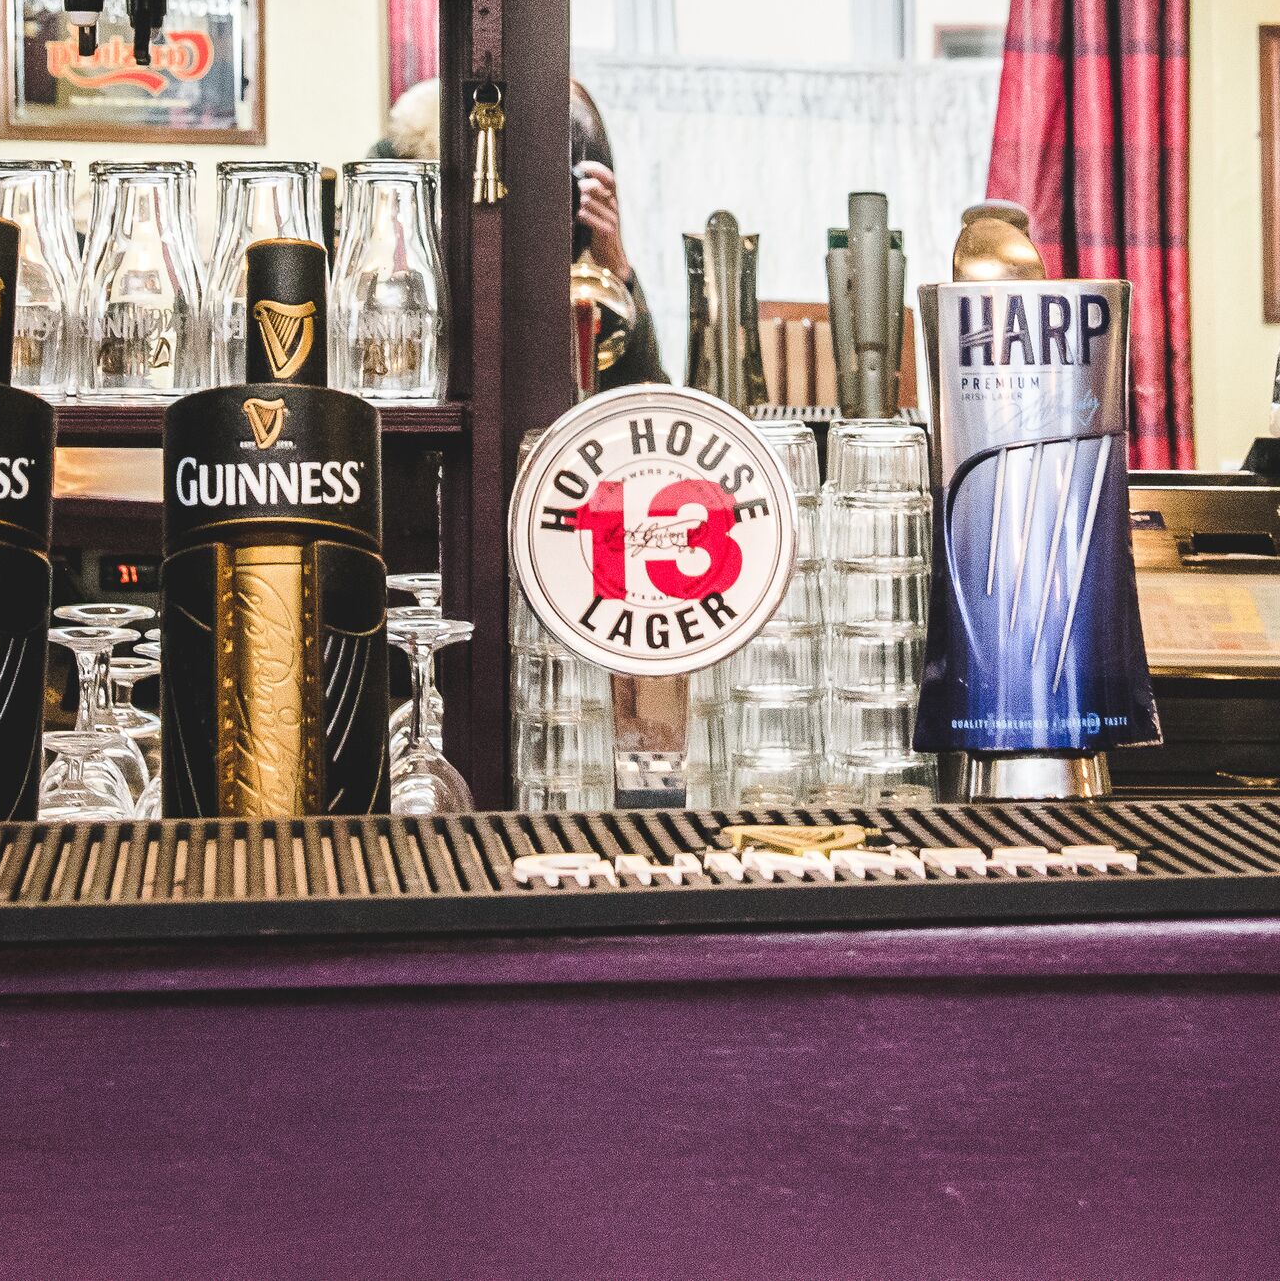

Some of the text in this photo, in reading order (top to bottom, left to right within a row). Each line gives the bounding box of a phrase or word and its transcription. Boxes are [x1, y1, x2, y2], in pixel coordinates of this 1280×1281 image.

[958, 294, 1111, 366] HARP
[961, 376, 1040, 390] PREMIUM
[961, 392, 985, 401] IRISH
[176, 455, 362, 508] GUINNESS
[540, 418, 770, 534] HOP HOUSE
[573, 478, 743, 601] 13
[578, 592, 739, 650] LAGER
[951, 718, 988, 730] QUALITY
[1104, 717, 1128, 726] TASTE
